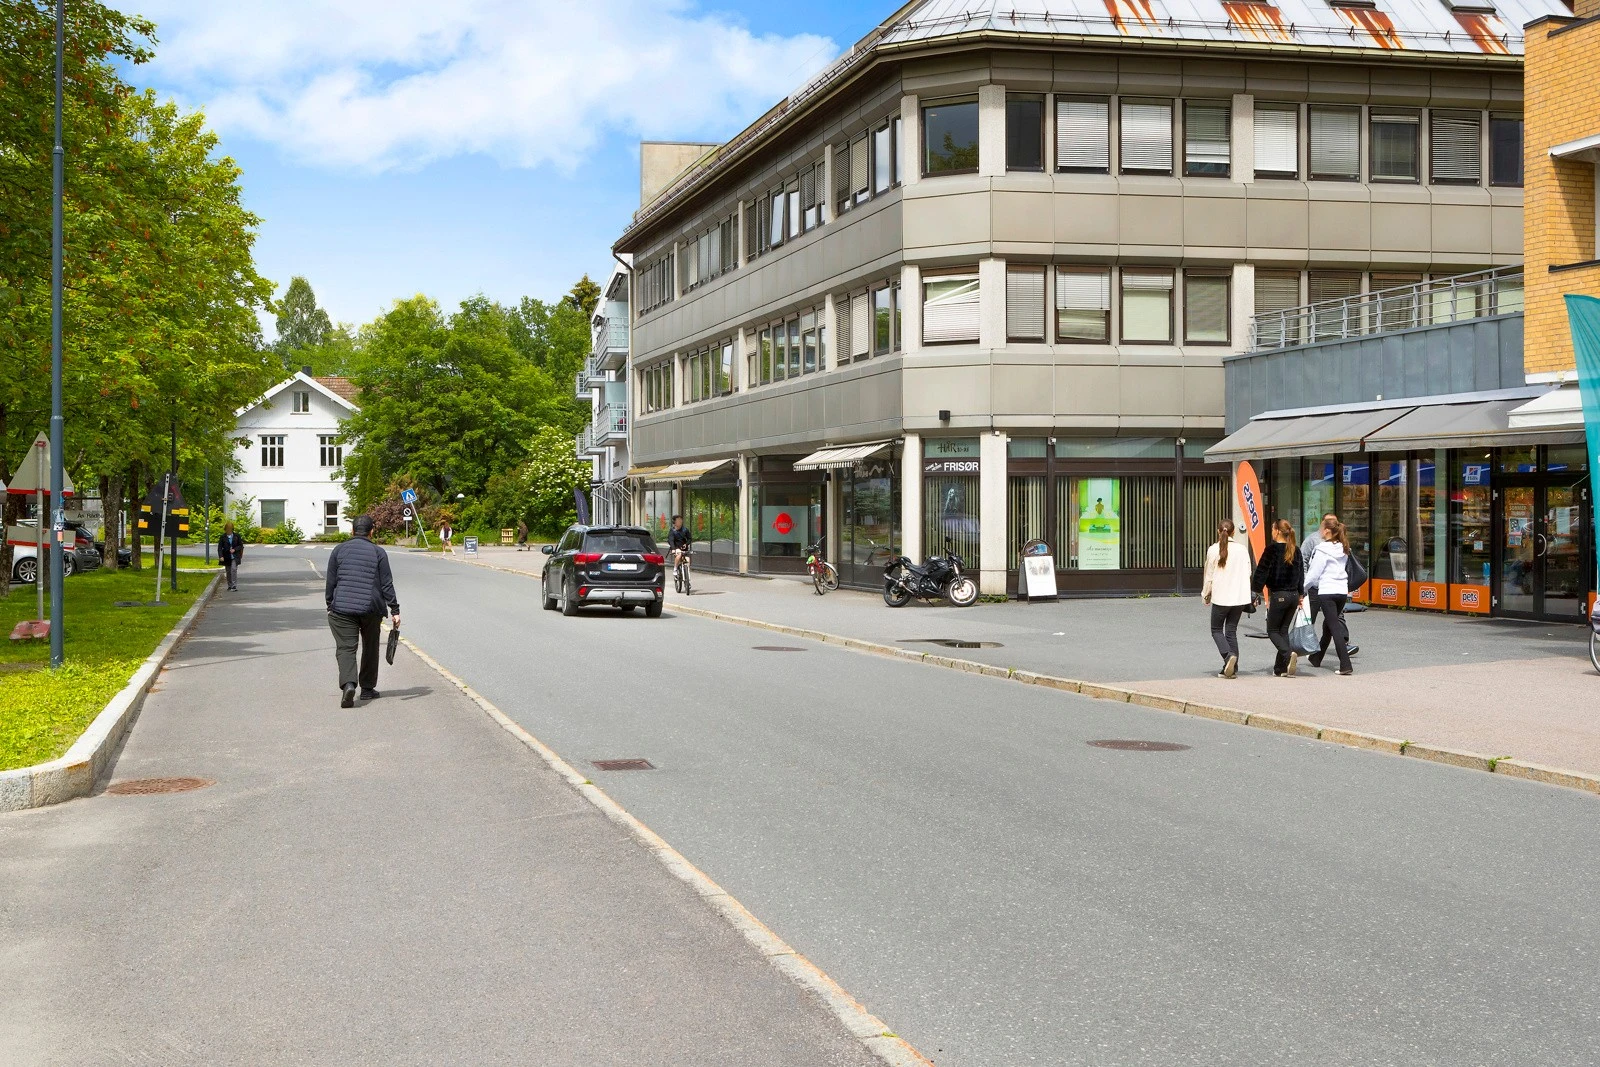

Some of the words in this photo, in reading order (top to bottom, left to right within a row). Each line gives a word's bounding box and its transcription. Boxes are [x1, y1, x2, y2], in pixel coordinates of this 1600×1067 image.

[943, 462, 979, 471] FRISØR
[1382, 586, 1396, 597] pets
[1421, 590, 1436, 600] pets
[1462, 593, 1478, 603] pets
